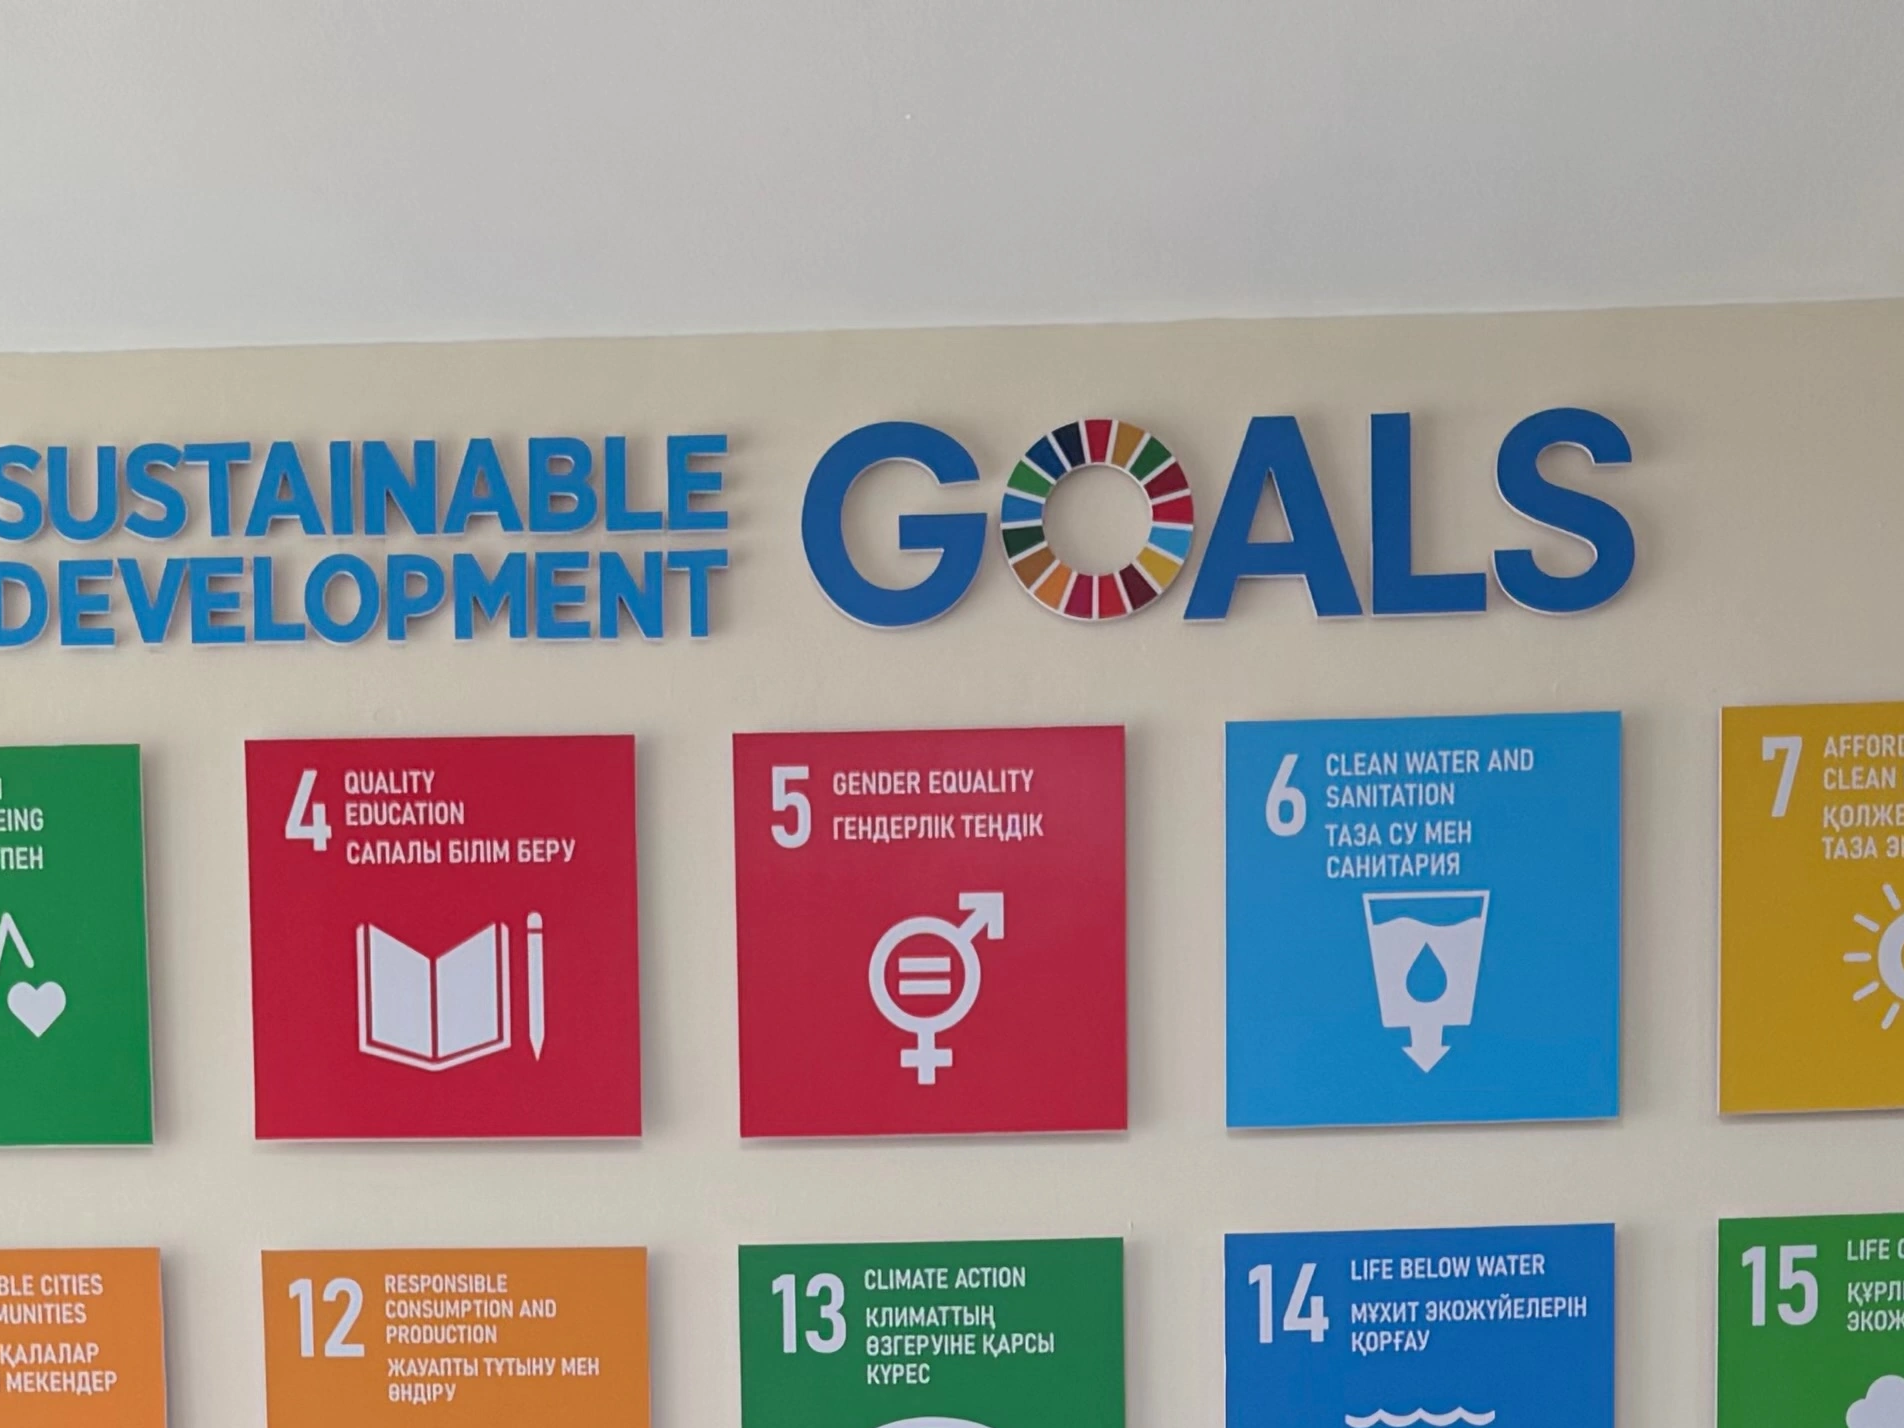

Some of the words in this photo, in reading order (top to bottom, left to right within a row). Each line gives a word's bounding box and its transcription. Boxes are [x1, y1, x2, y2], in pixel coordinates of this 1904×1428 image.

[801, 405, 1635, 630] GOALS
[1327, 752, 1397, 776] CLEAN
[1406, 750, 1479, 773] WATER
[1488, 749, 1533, 772] AND
[345, 771, 434, 794] QUALITY
[834, 772, 920, 795] GENDER
[929, 769, 1033, 793] EQUALITY
[1762, 736, 1802, 817] 7
[1824, 767, 1896, 790] CLEAN
[772, 766, 811, 848] 5
[1266, 754, 1306, 836] 6
[1327, 783, 1454, 808] SANITATION
[285, 769, 332, 852] 4
[346, 802, 464, 825] EDUCATION
[347, 841, 441, 864] САПАЛЫ
[449, 840, 509, 863] БІЛІМ
[518, 839, 575, 862] БЕРУ
[1822, 836, 1877, 859] ТАЗА
[1848, 1239, 1890, 1260] LIFE
[865, 1268, 948, 1289] CLIMATE
[955, 1267, 1025, 1288] ACTION
[1352, 1259, 1393, 1280] LIFE
[1401, 1257, 1470, 1278] BELOW
[1477, 1254, 1544, 1276] WATER
[41, 1274, 103, 1295] CITIES
[385, 1274, 507, 1293] RESPONSIBLE
[1742, 1245, 1818, 1326] 15
[386, 1300, 513, 1318] CONSUMPTION
[520, 1300, 556, 1317] AND
[771, 1272, 848, 1355] 13
[1249, 1263, 1329, 1343] 14
[289, 1278, 364, 1357] 12
[387, 1325, 496, 1343] PRODUCTION
